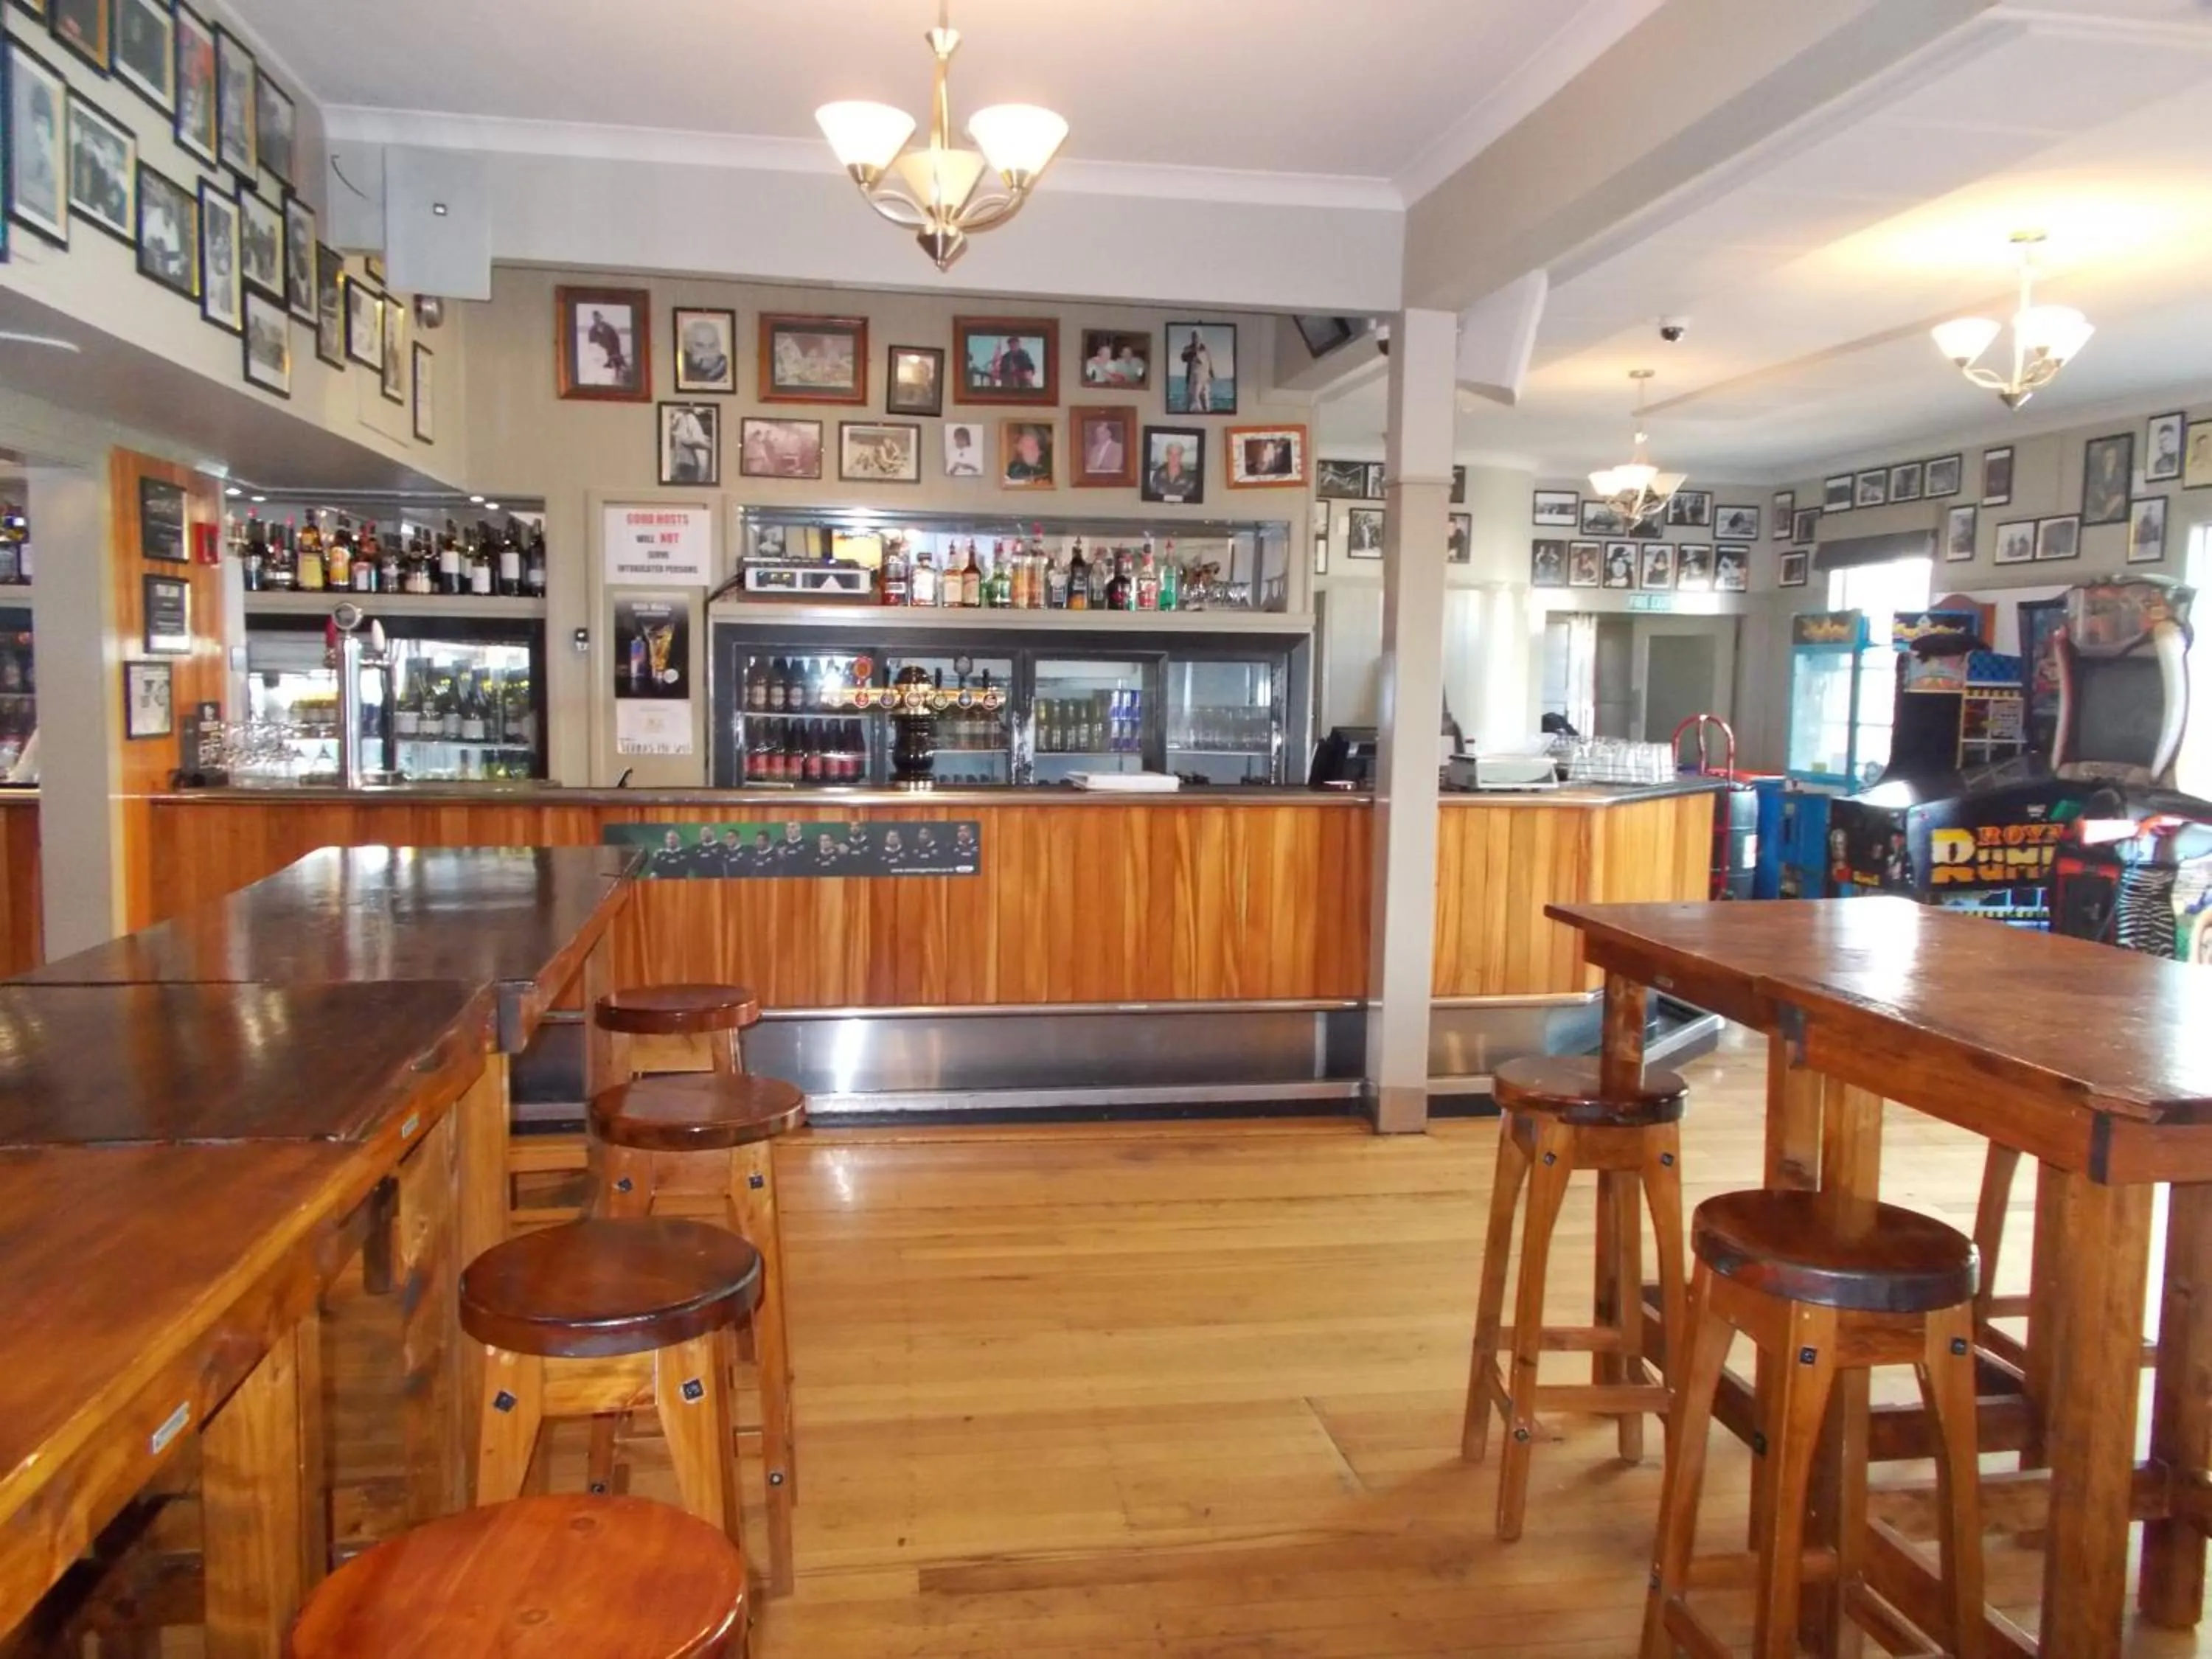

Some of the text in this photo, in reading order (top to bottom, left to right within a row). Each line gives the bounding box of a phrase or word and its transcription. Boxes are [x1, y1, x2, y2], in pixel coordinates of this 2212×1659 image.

[627, 513, 689, 525] GOOD HOSTS
[636, 532, 680, 543] WILL NOT
[617, 564, 664, 573] INTOXICATED
